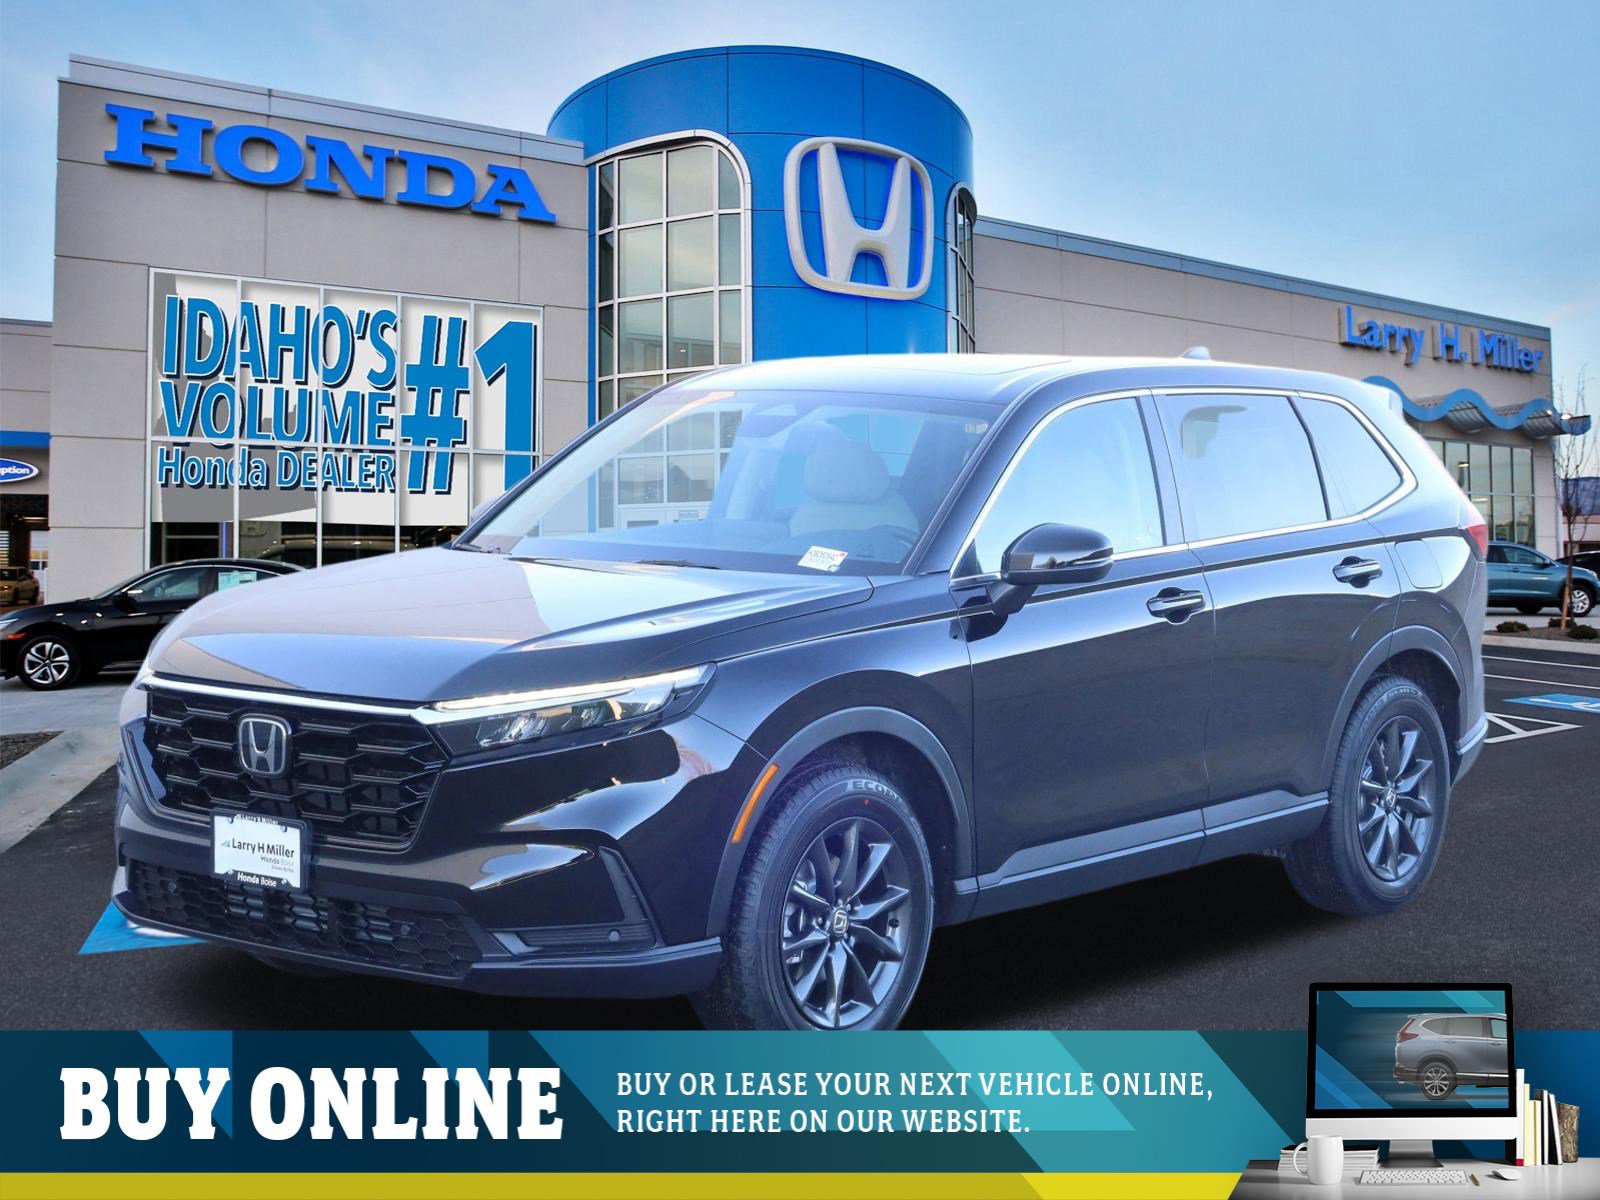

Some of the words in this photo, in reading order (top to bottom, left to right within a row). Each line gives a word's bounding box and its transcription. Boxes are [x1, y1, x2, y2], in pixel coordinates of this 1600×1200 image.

[104, 102, 557, 224] HONDA
[162, 295, 398, 389] IDAHO'S
[1338, 304, 1425, 366] Larry
[1433, 322, 1468, 363] H.
[1472, 329, 1544, 374] Miller
[159, 380, 396, 450] VOLUME
[157, 447, 269, 490] Honda
[276, 450, 396, 492] DEALER
[232, 838, 256, 854] Larry
[257, 842, 265, 854] H
[267, 844, 295, 858] Miller
[237, 872, 259, 884] Honda
[260, 877, 277, 888] Boise
